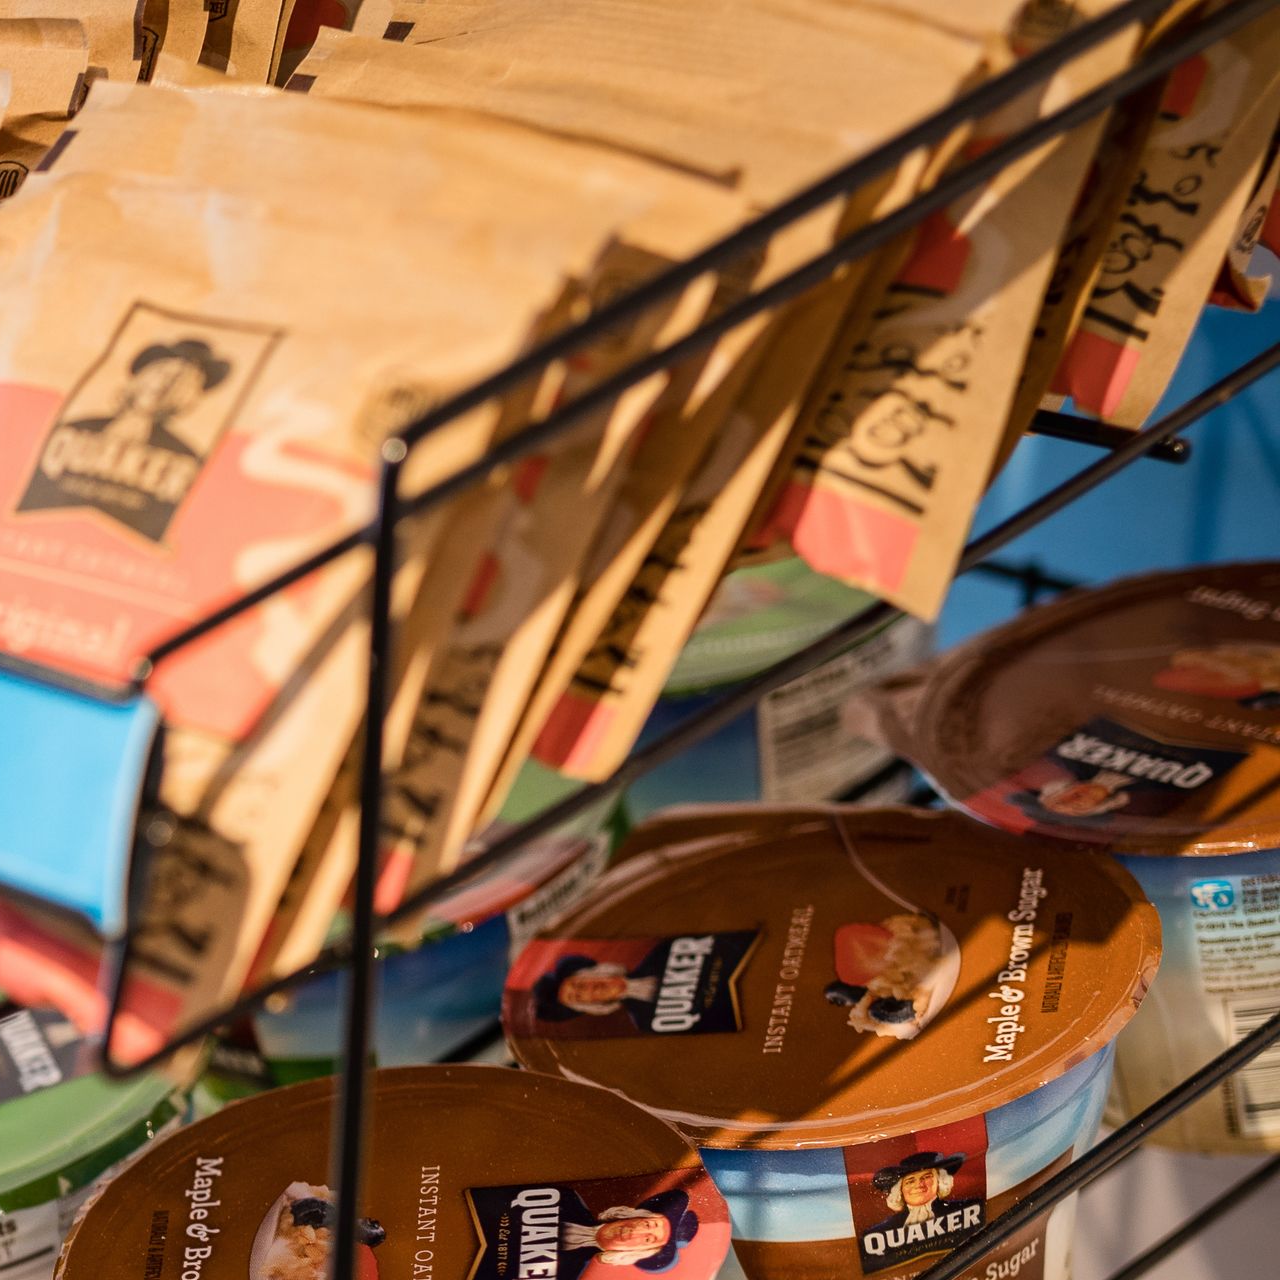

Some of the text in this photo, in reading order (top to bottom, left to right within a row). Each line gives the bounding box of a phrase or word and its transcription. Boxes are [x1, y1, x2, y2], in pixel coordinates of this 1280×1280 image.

[44, 427, 203, 500] QUAKER
[1057, 733, 1214, 789] QUAKER
[651, 935, 715, 1032] QUAKER
[762, 904, 814, 1054] INSTANT OATMEAL
[983, 867, 1048, 1063] Maple & Brown Sugar
[184, 1156, 225, 1220] Maple
[416, 1165, 440, 1242] INSTANT
[186, 1222, 221, 1242] &
[497, 1242, 508, 1261] 1877
[863, 1203, 981, 1257] QUAKER
